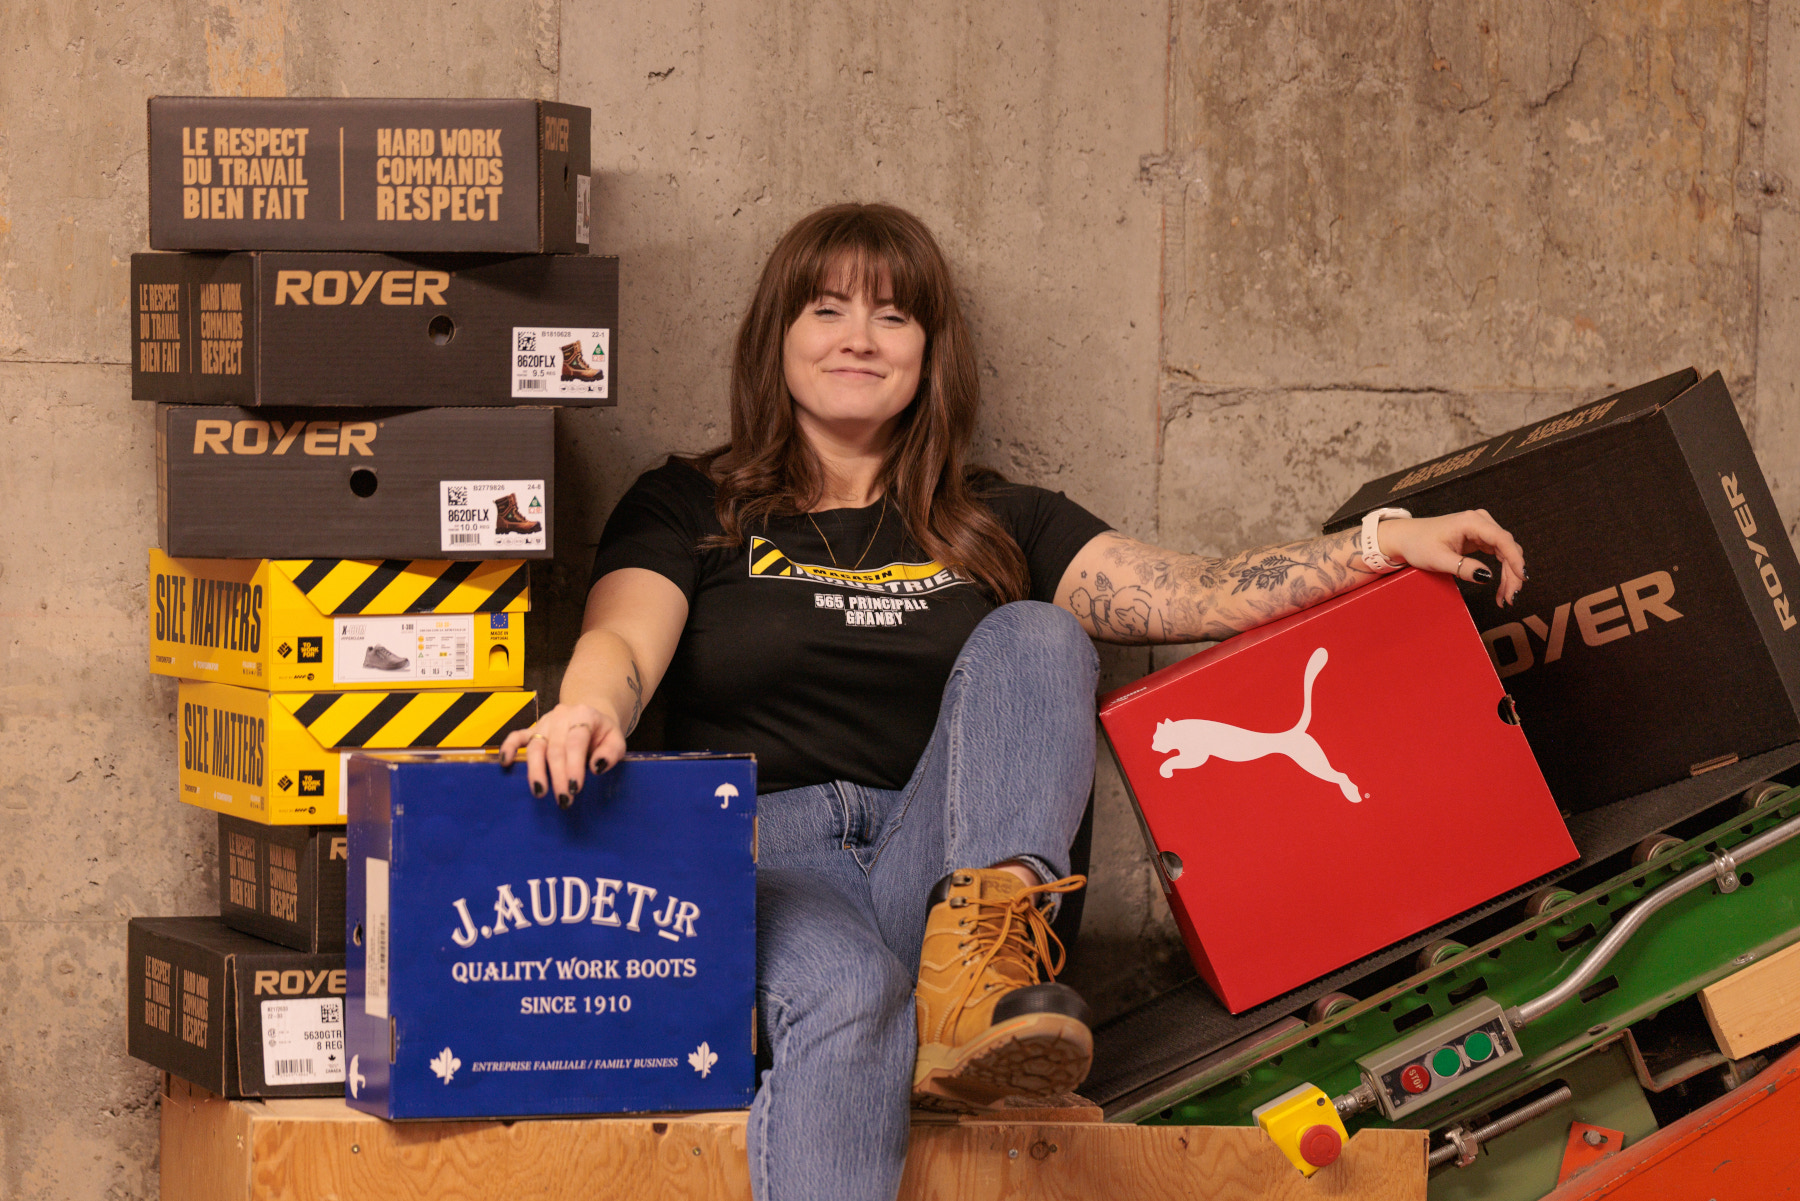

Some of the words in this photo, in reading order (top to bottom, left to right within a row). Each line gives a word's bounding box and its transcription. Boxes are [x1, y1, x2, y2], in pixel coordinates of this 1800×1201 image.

[183, 127, 208, 156] LE
[214, 127, 309, 157] RESPECT
[377, 128, 435, 157] HARD
[440, 128, 503, 157] WORK
[544, 115, 569, 152] ROYER
[183, 157, 212, 186] DU
[218, 158, 308, 186] TRAVAIL
[376, 157, 504, 186] COMMANDS
[183, 187, 244, 220] BIEN
[252, 187, 309, 220] FAIT
[377, 186, 503, 221] RESPECT
[140, 284, 148, 311] LE
[149, 284, 180, 311] RESPECT
[200, 284, 220, 311] HARD
[220, 283, 242, 311] WORK
[275, 270, 450, 306] ROYER
[140, 313, 150, 340] DU
[151, 313, 180, 340] TRAVAIL
[200, 312, 243, 339] COMMANDS
[140, 342, 160, 373] BIEN
[162, 342, 180, 373] FAIT
[201, 340, 243, 375] RESPECT
[517, 355, 556, 368] 8620FLX
[532, 369, 545, 377] 9.5
[193, 419, 377, 456] ROYER
[448, 509, 490, 522] 8620FLX
[460, 523, 478, 531] 10.0
[1720, 471, 1797, 631] ROYER
[813, 568, 893, 581] MAGASIN
[156, 573, 186, 644] SIZE
[189, 577, 263, 653] MATTERS
[814, 594, 844, 609] 565
[848, 595, 929, 612] PRINCIPALE
[846, 610, 904, 627] GRANBY
[1480, 570, 1684, 678] OYER
[184, 702, 209, 773] SIZE
[211, 708, 265, 787] MATTERS
[270, 887, 298, 923] RESPECT
[254, 970, 347, 995] ROYE
[452, 956, 553, 984] QUALITY
[556, 956, 621, 980] WORK
[626, 958, 698, 978] BOOTS
[520, 995, 577, 1015] SINCE
[583, 994, 632, 1015] 1910
[182, 1013, 209, 1049] RESPECT
[304, 1030, 342, 1040] 5630GTR
[317, 1041, 322, 1050] 8
[326, 1040, 343, 1050] REG
[472, 1061, 532, 1073] ENTREPRISE
[533, 1059, 587, 1071] FAMILIALE
[594, 1058, 631, 1070] FAMILY
[633, 1057, 679, 1069] BUSINESS
[1408, 1069, 1424, 1089] STOP
